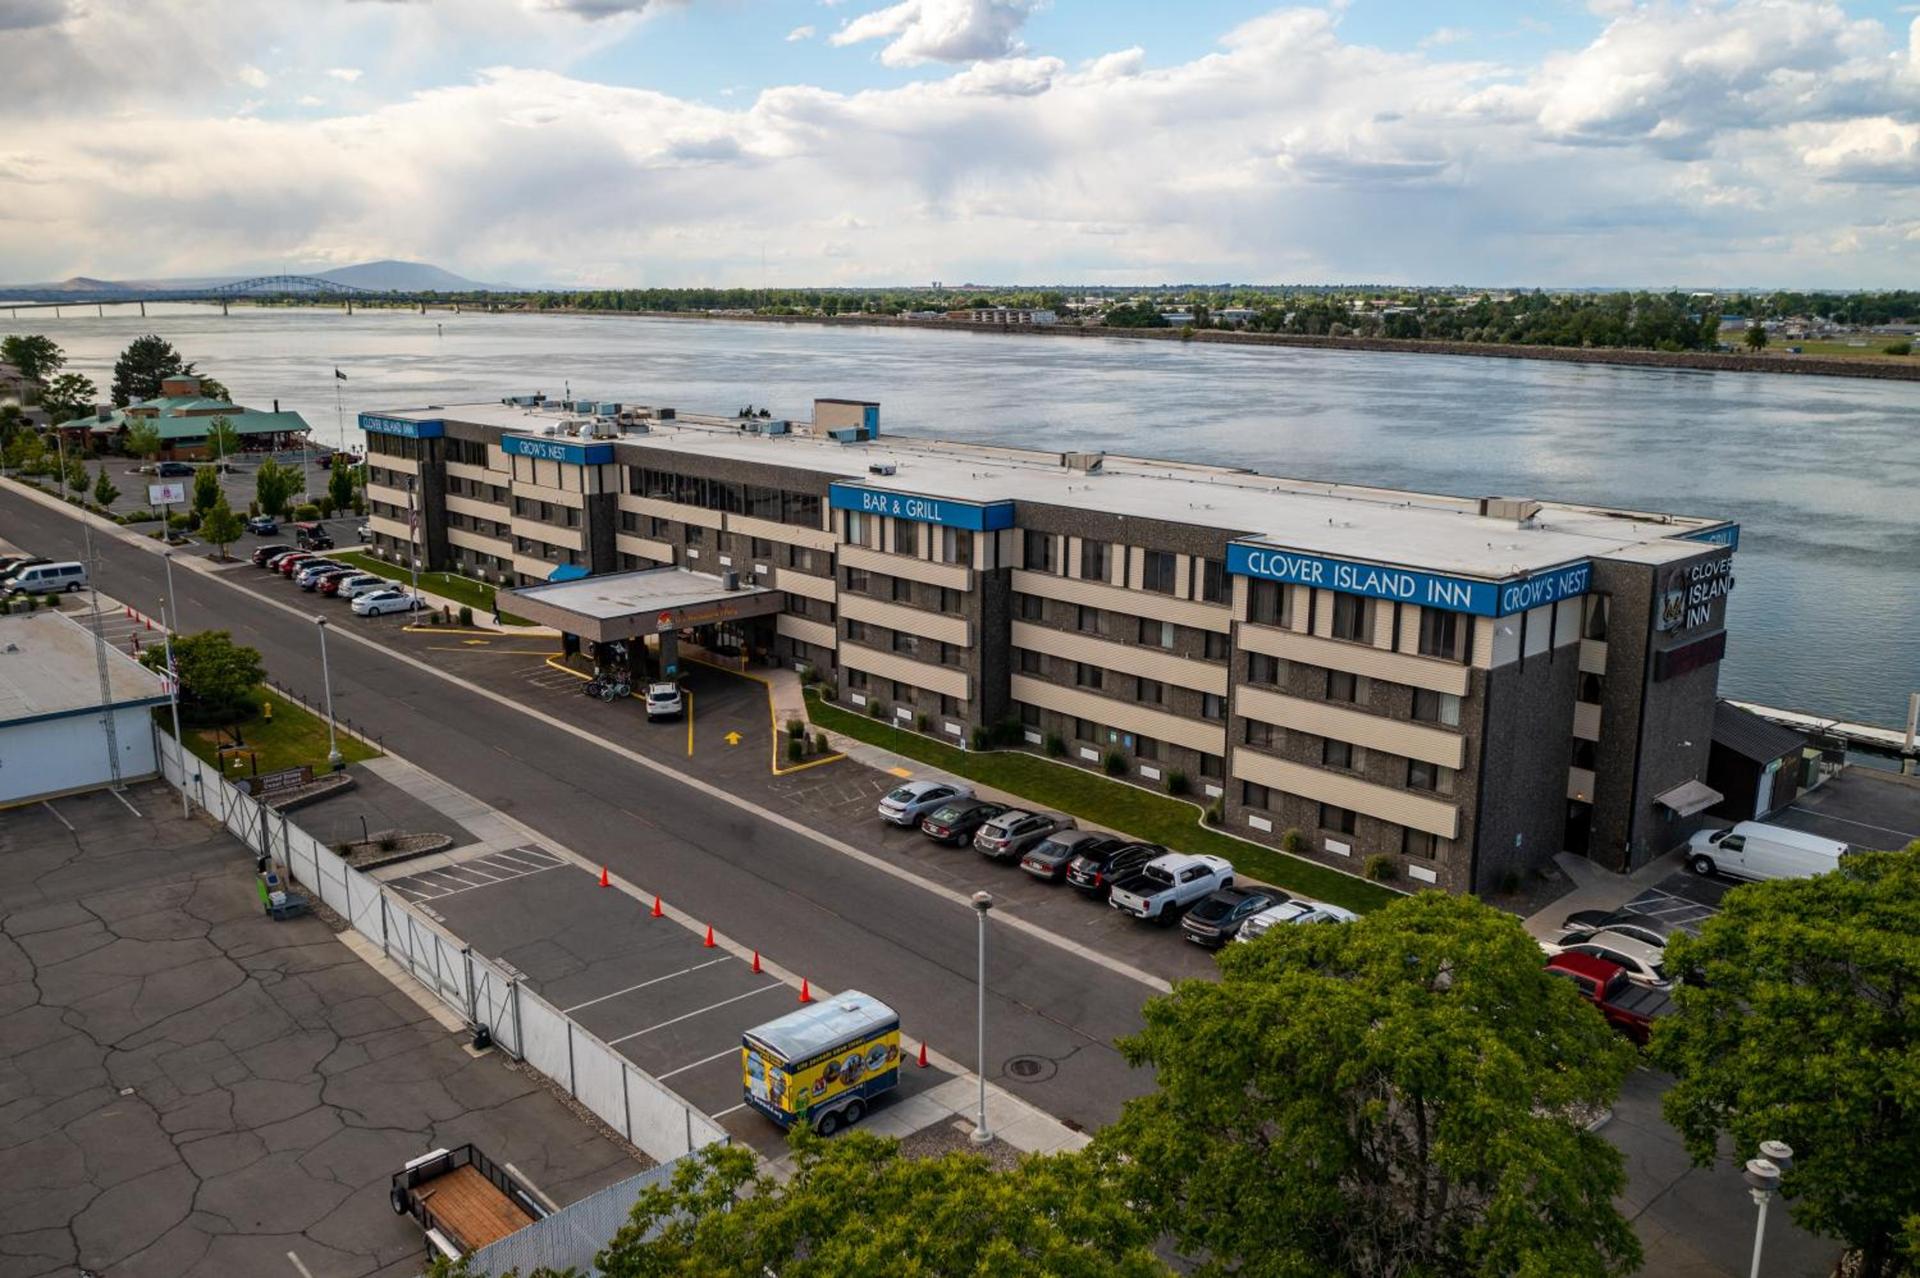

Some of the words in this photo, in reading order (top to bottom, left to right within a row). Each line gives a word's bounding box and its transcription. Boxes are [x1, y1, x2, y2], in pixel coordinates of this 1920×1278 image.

[548, 445, 566, 460] NEST
[863, 493, 887, 512] BAR
[892, 500, 900, 514] &
[906, 500, 942, 521] GRILL
[1248, 552, 1323, 584] CLOVER
[1334, 565, 1415, 598] ISLAND
[1428, 579, 1471, 608] INN
[1503, 578, 1553, 611] CROW'S
[1559, 568, 1588, 596] NEST
[1689, 576, 1735, 606] ISLAND
[1686, 603, 1711, 631] INN
